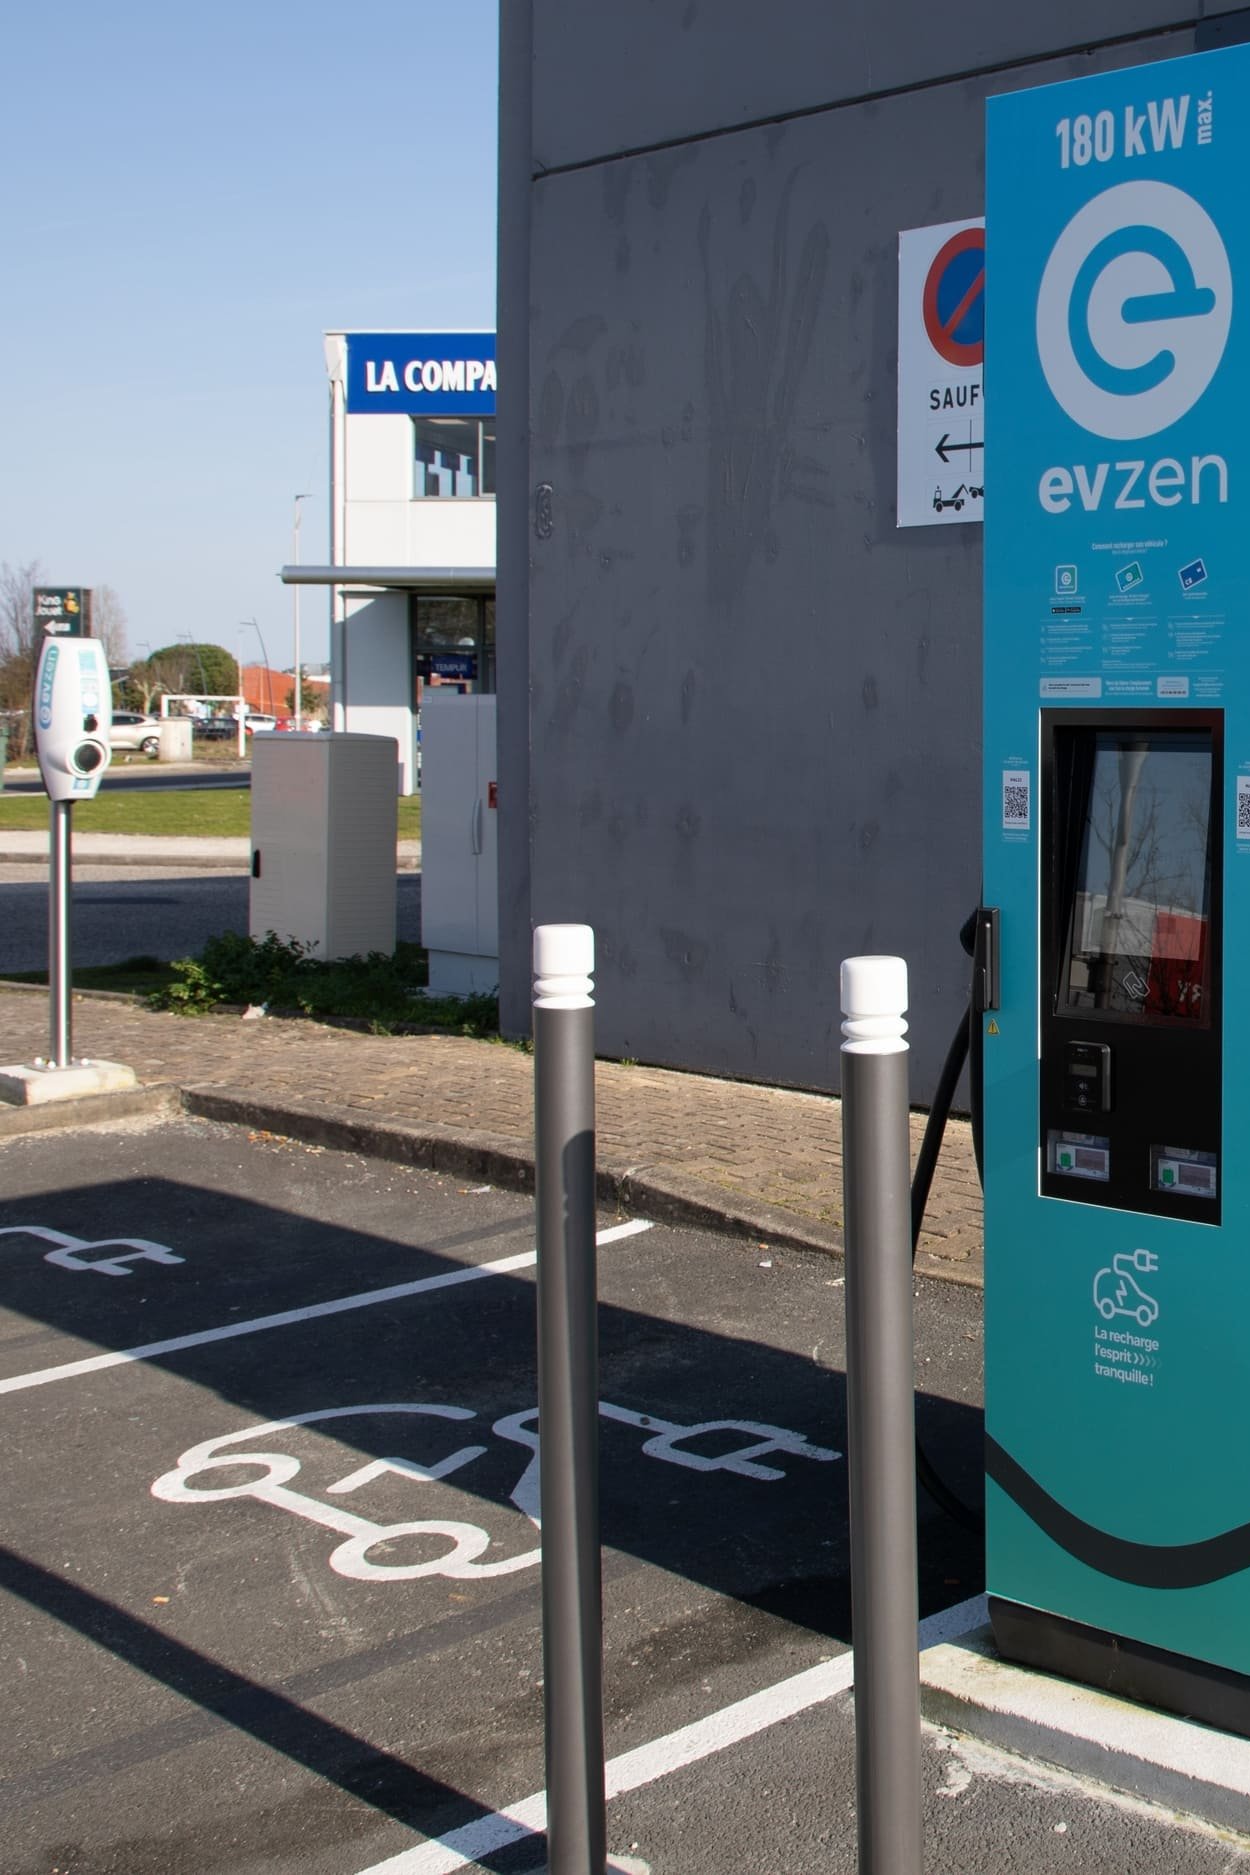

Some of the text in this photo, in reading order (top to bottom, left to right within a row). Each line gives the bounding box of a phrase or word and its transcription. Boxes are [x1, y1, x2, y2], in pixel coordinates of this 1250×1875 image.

[1055, 90, 1213, 169] 180 kW max.
[366, 359, 497, 393] LA COMPA
[929, 383, 980, 411] SAUF
[1038, 451, 1229, 515] evzen
[1094, 1325, 1159, 1351] La recharge
[1094, 1343, 1132, 1364] l'esprit
